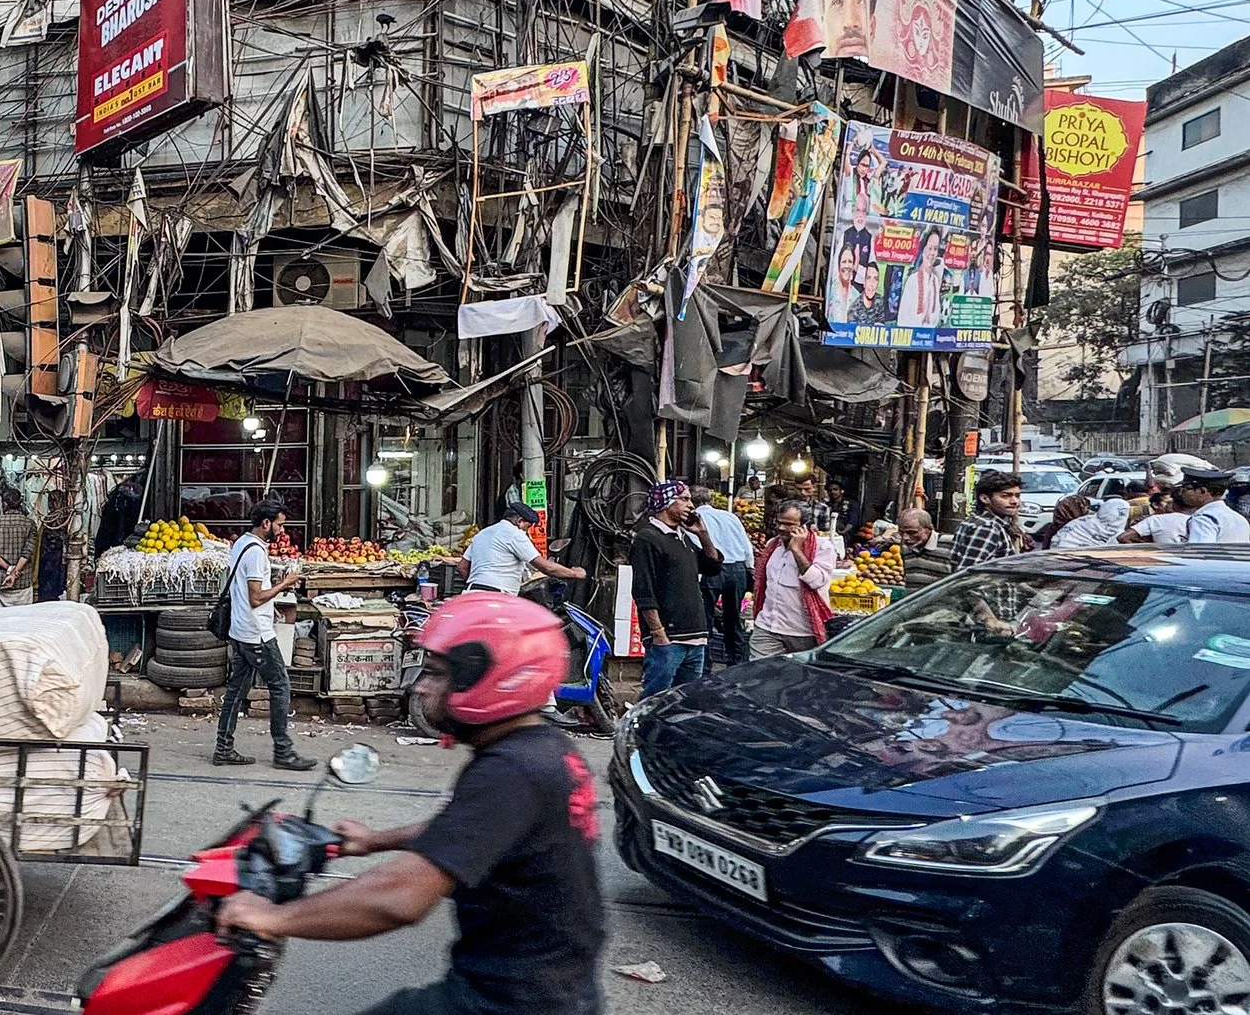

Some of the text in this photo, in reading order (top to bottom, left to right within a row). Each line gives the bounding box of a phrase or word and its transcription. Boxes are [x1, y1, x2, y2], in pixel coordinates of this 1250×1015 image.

[94, 38, 164, 97] ELEGANT
[148, 77, 161, 90] BAR
[1051, 130, 1109, 151] GOPAL
[900, 142, 916, 157] On
[917, 145, 937, 161] 14th
[1046, 146, 1111, 169] BISHOYI
[915, 168, 973, 198] MLA CUP
[910, 206, 923, 221] 41
[924, 207, 950, 224] WARD
[1105, 201, 1125, 210] 5371
[960, 372, 972, 383] NO
